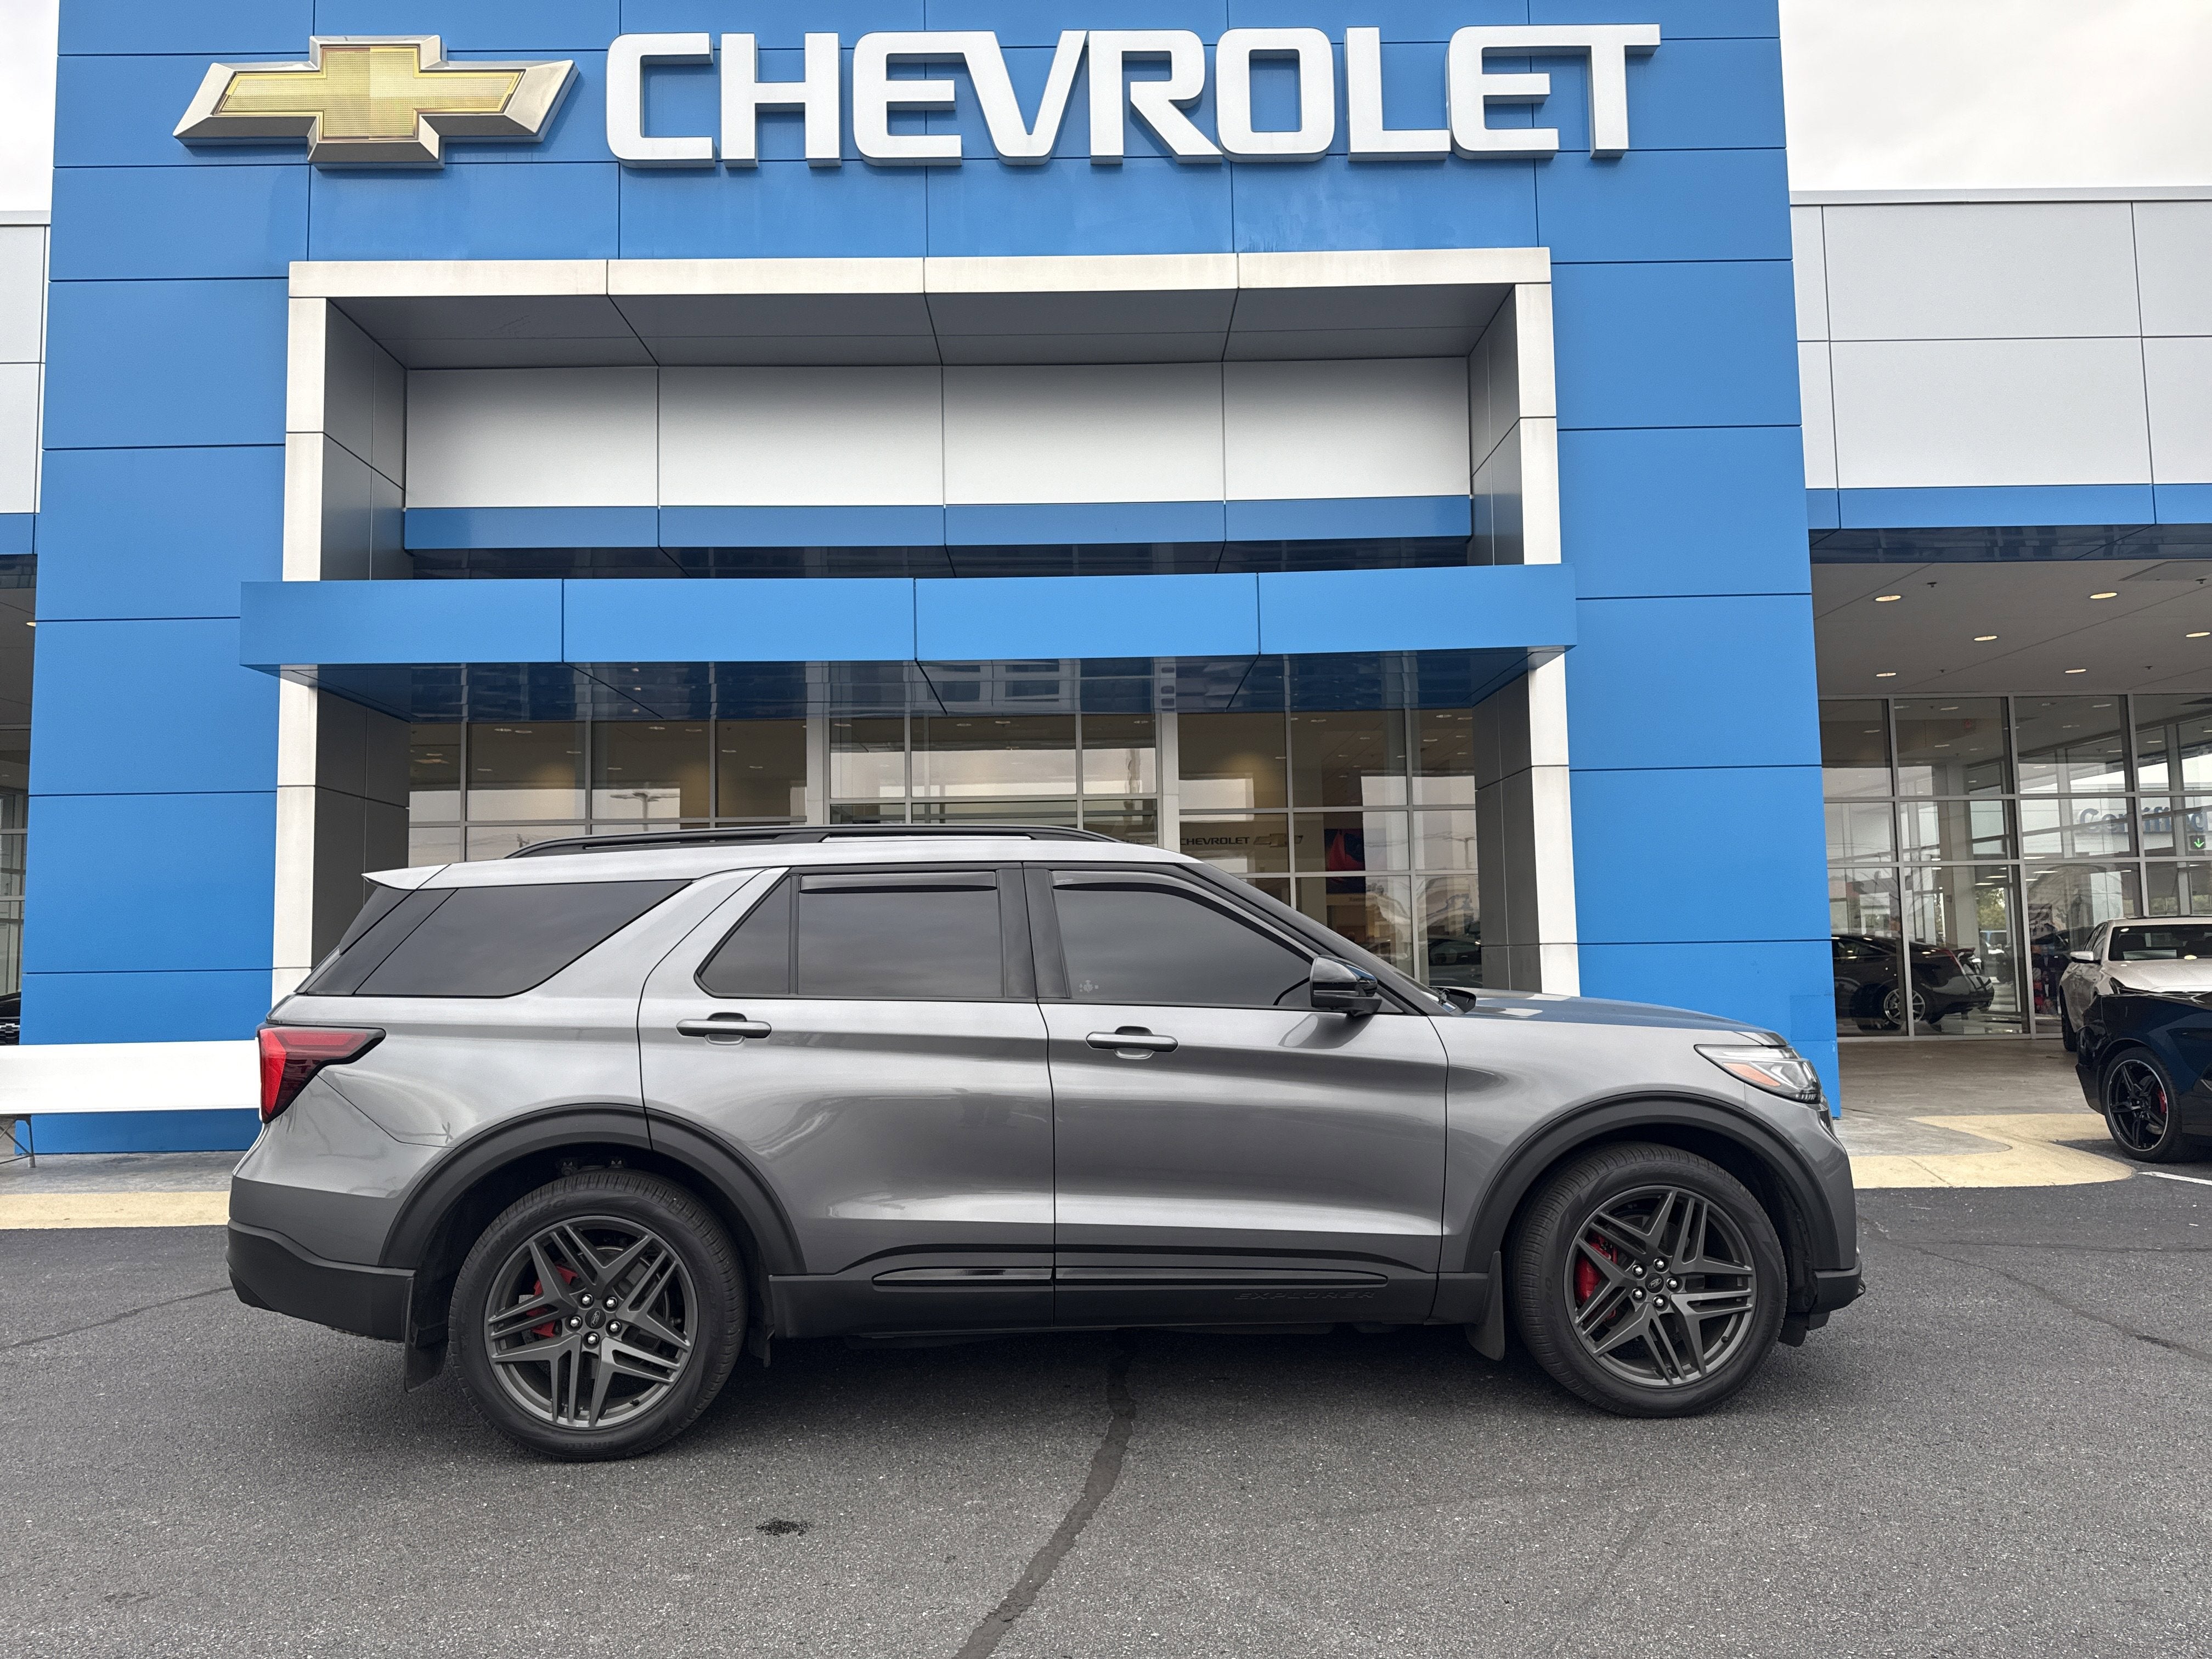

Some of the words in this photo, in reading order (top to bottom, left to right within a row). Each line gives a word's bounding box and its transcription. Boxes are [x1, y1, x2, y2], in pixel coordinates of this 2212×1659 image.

[606, 23, 1661, 168] CHEVROLET
[2080, 806, 2204, 833] Cerifid
[1181, 836, 1250, 845] CHEVROLET
